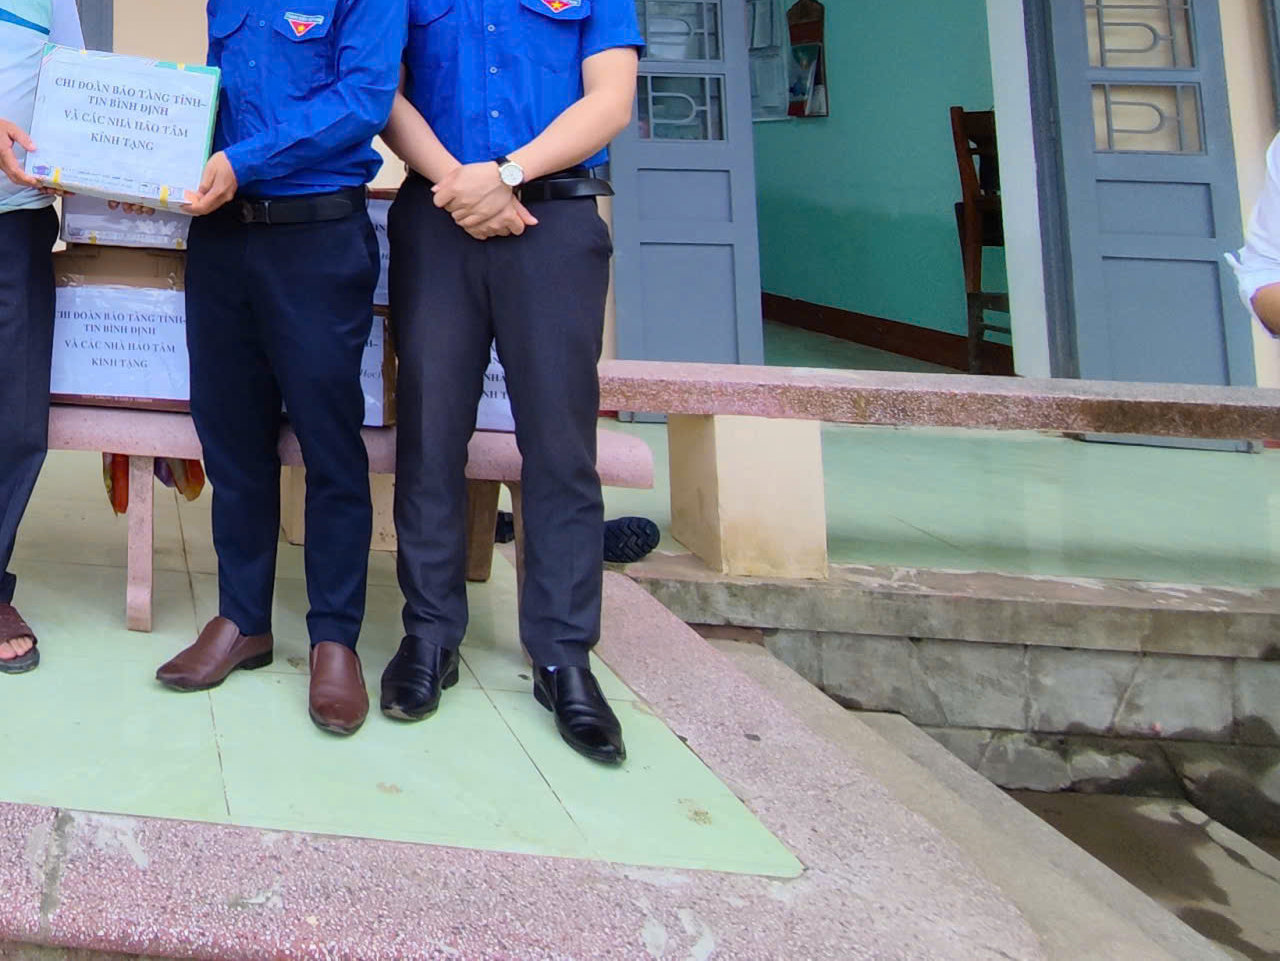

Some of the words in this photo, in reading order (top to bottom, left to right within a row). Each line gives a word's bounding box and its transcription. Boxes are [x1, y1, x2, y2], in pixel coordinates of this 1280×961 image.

[55, 77, 75, 88] CHI
[78, 80, 110, 93] ĐOÀN
[138, 88, 170, 103] TÀNG
[88, 95, 108, 107] TIN
[109, 98, 137, 111] BÌNH
[140, 104, 169, 116] ĐỊNH
[64, 109, 78, 121] VÀ
[81, 111, 106, 125] CÁC
[107, 117, 132, 130] NHÀ
[162, 124, 188, 138] TÂM
[91, 132, 120, 145] KÍNH
[122, 137, 154, 151] TẠNG
[56, 310, 71, 319] HI
[73, 310, 101, 321] ĐOÀN
[127, 311, 155, 323] TÀNG
[84, 324, 101, 333] TIN
[103, 324, 128, 334] BÌNH
[130, 326, 156, 337] ĐỊNH
[64, 338, 78, 349] VÀ
[80, 339, 102, 350] CÁC
[104, 340, 125, 351] NHÀ
[152, 342, 176, 353] TÂM
[91, 357, 117, 367] KÍNH
[120, 359, 148, 369] TẠNG
